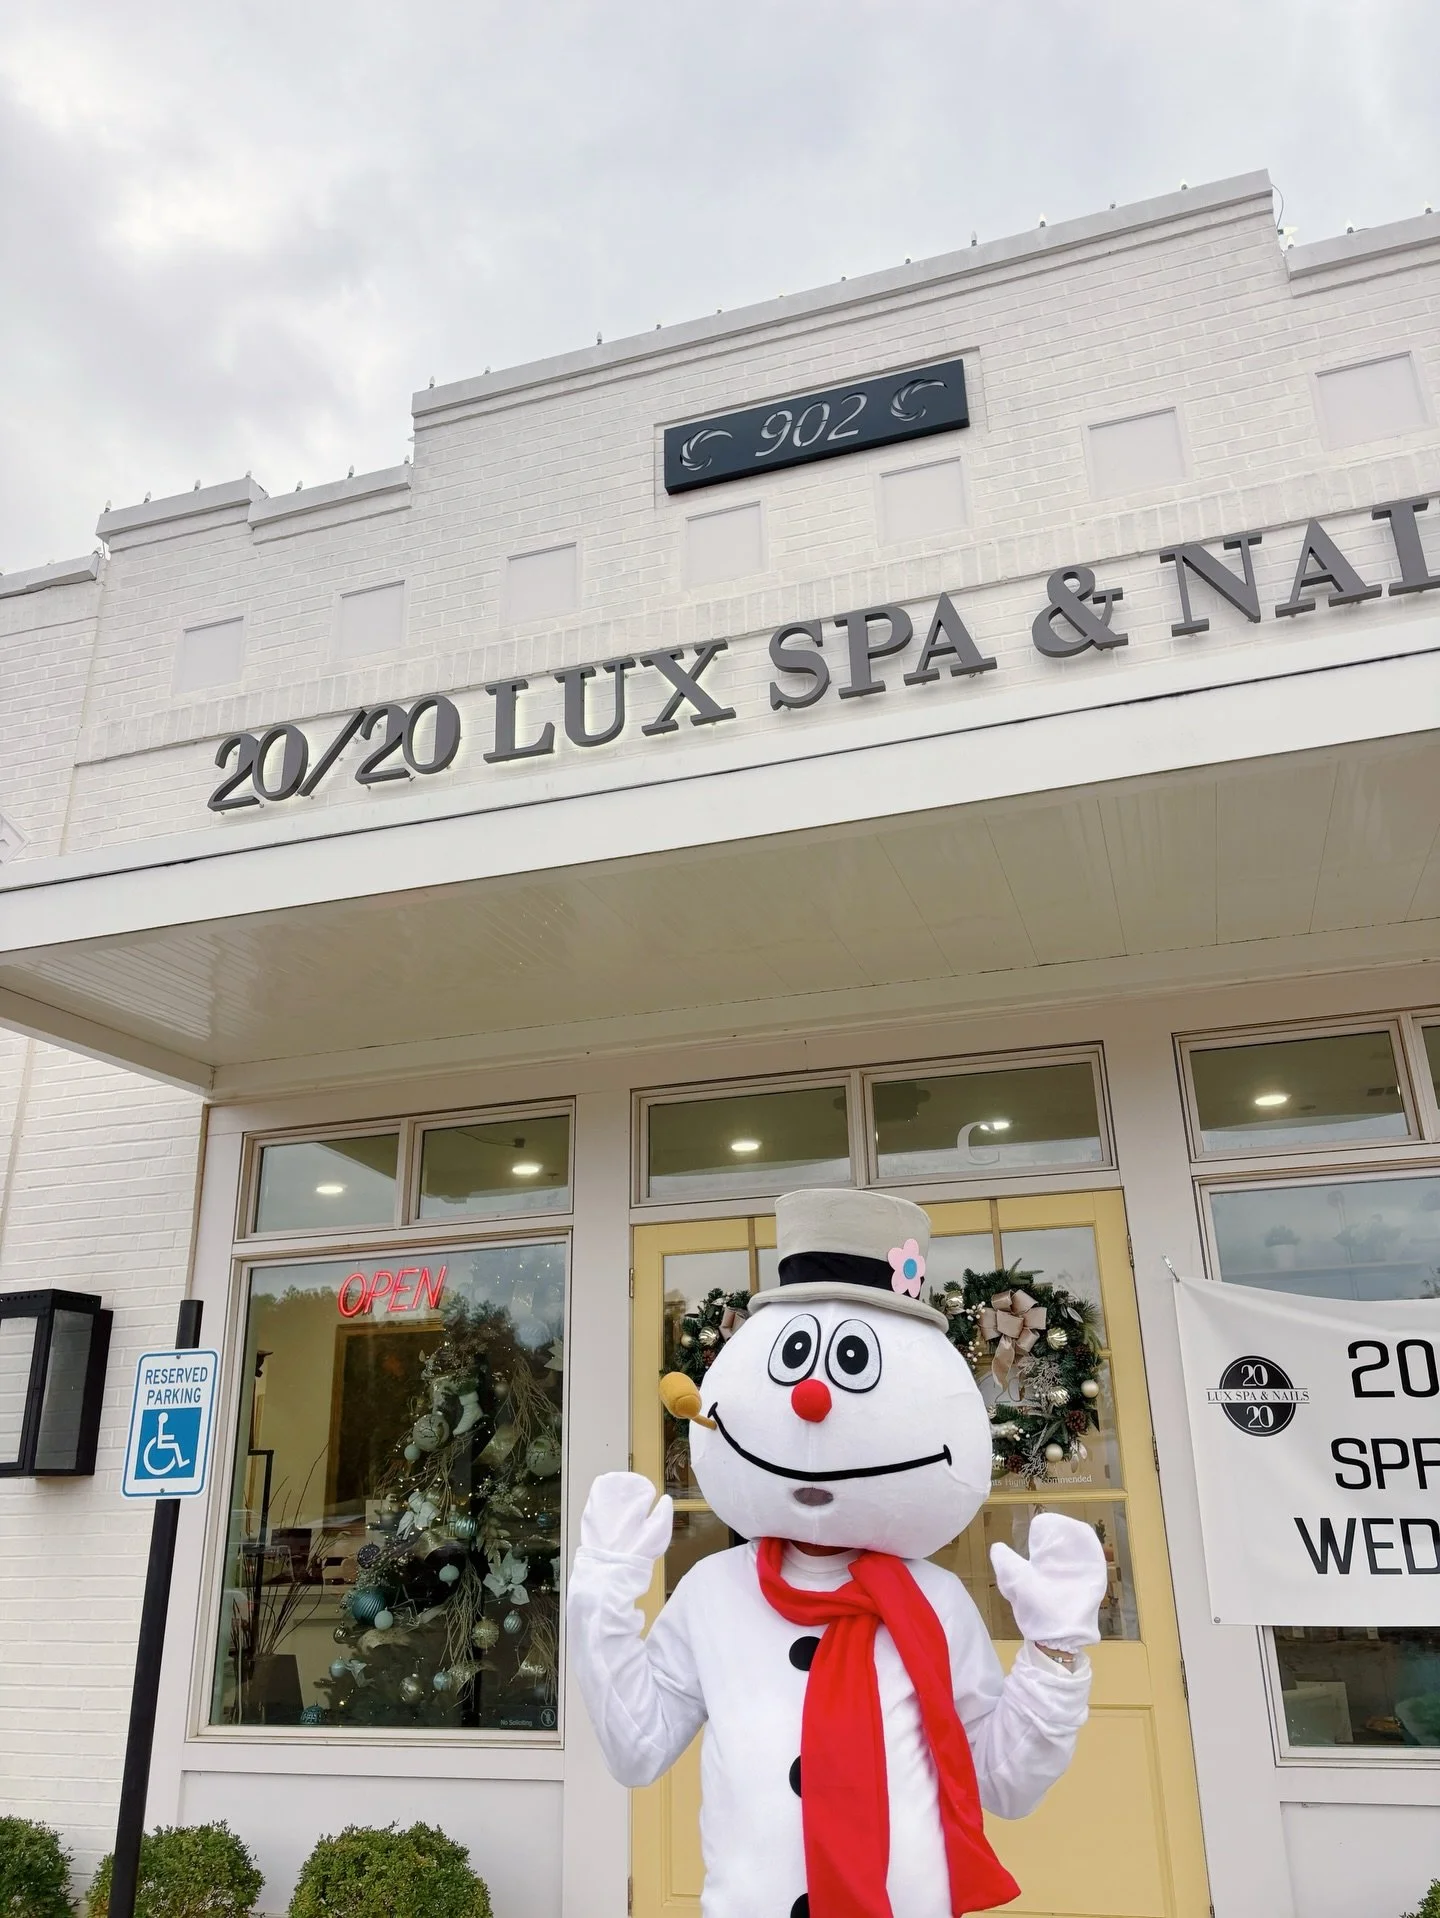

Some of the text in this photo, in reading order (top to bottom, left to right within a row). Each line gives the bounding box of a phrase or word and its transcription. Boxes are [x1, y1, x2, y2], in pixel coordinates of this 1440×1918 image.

[755, 391, 868, 457] 902
[207, 694, 461, 811] 20/20
[482, 639, 737, 764] LUX
[768, 591, 998, 711] SPA
[1031, 565, 1129, 659] &
[337, 1265, 448, 1318] OPEN
[144, 1366, 208, 1385] RESERVED
[1241, 1364, 1268, 1387] 20
[1347, 1339, 1440, 1398] 20
[146, 1387, 201, 1406] PARKING
[1207, 1391, 1310, 1402] LUX SPA & NAILS
[1246, 1405, 1274, 1428] 20
[1293, 1517, 1440, 1575] WED
